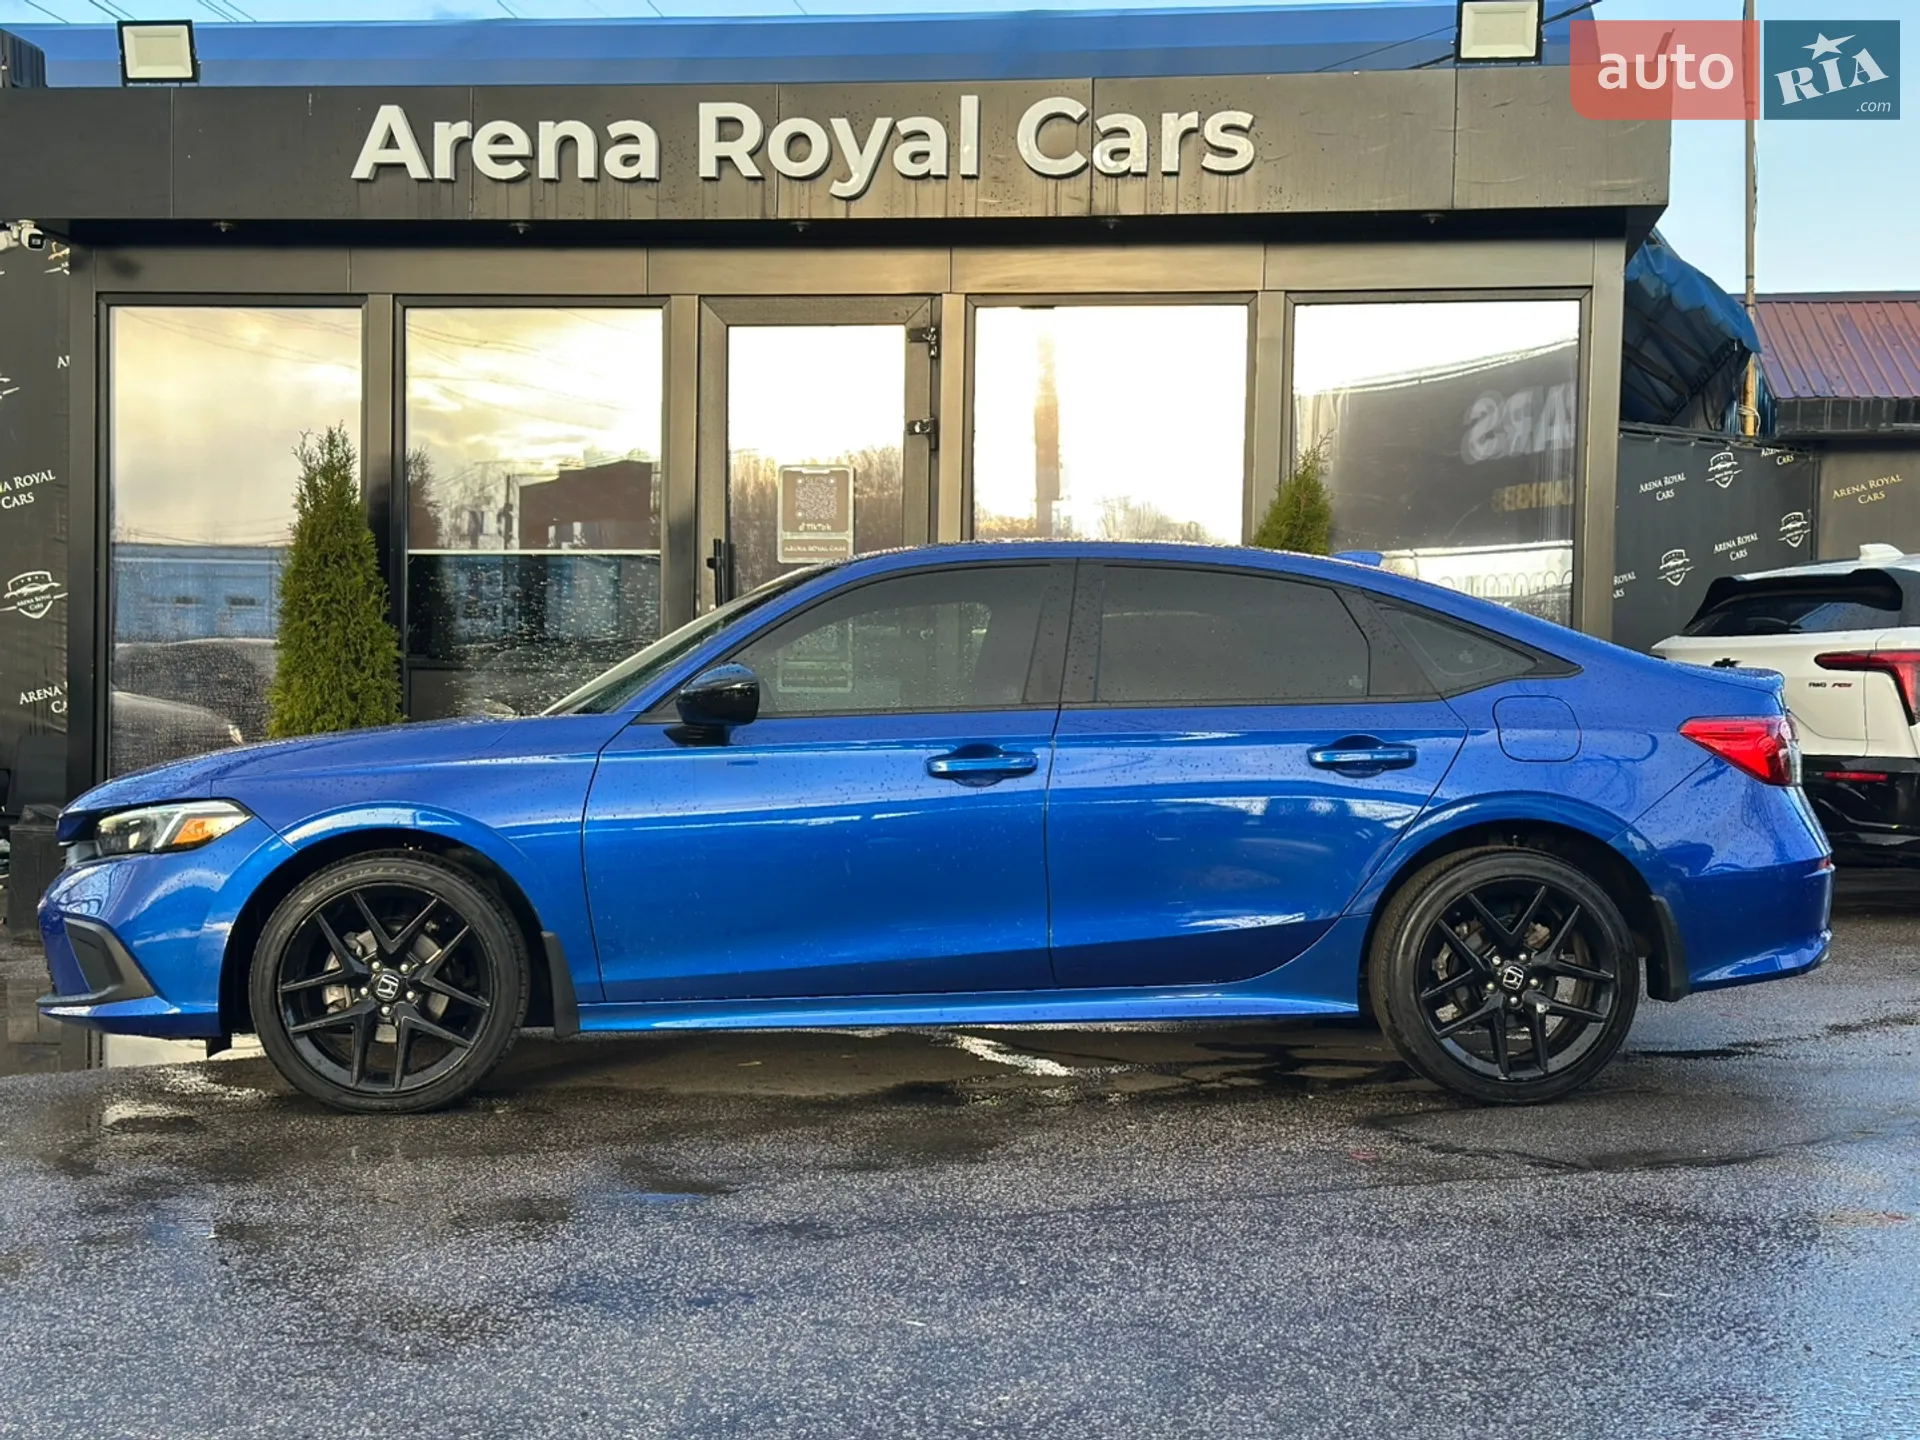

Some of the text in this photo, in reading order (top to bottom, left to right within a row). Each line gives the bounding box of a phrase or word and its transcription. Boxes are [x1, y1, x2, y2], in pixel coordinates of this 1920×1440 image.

[351, 95, 1256, 200] Arena Royal Cars
[13, 469, 56, 489] ROYAL
[1638, 472, 1687, 493] ARENA ROYAL
[1832, 474, 1903, 499] ARENA ROYAL
[1, 491, 35, 509] CARS
[1656, 488, 1675, 501] CARS
[1857, 490, 1886, 504] CARS
[1713, 532, 1759, 554] ARENA ROYAL
[1729, 548, 1748, 561] CARS
[19, 685, 63, 705] ARENA
